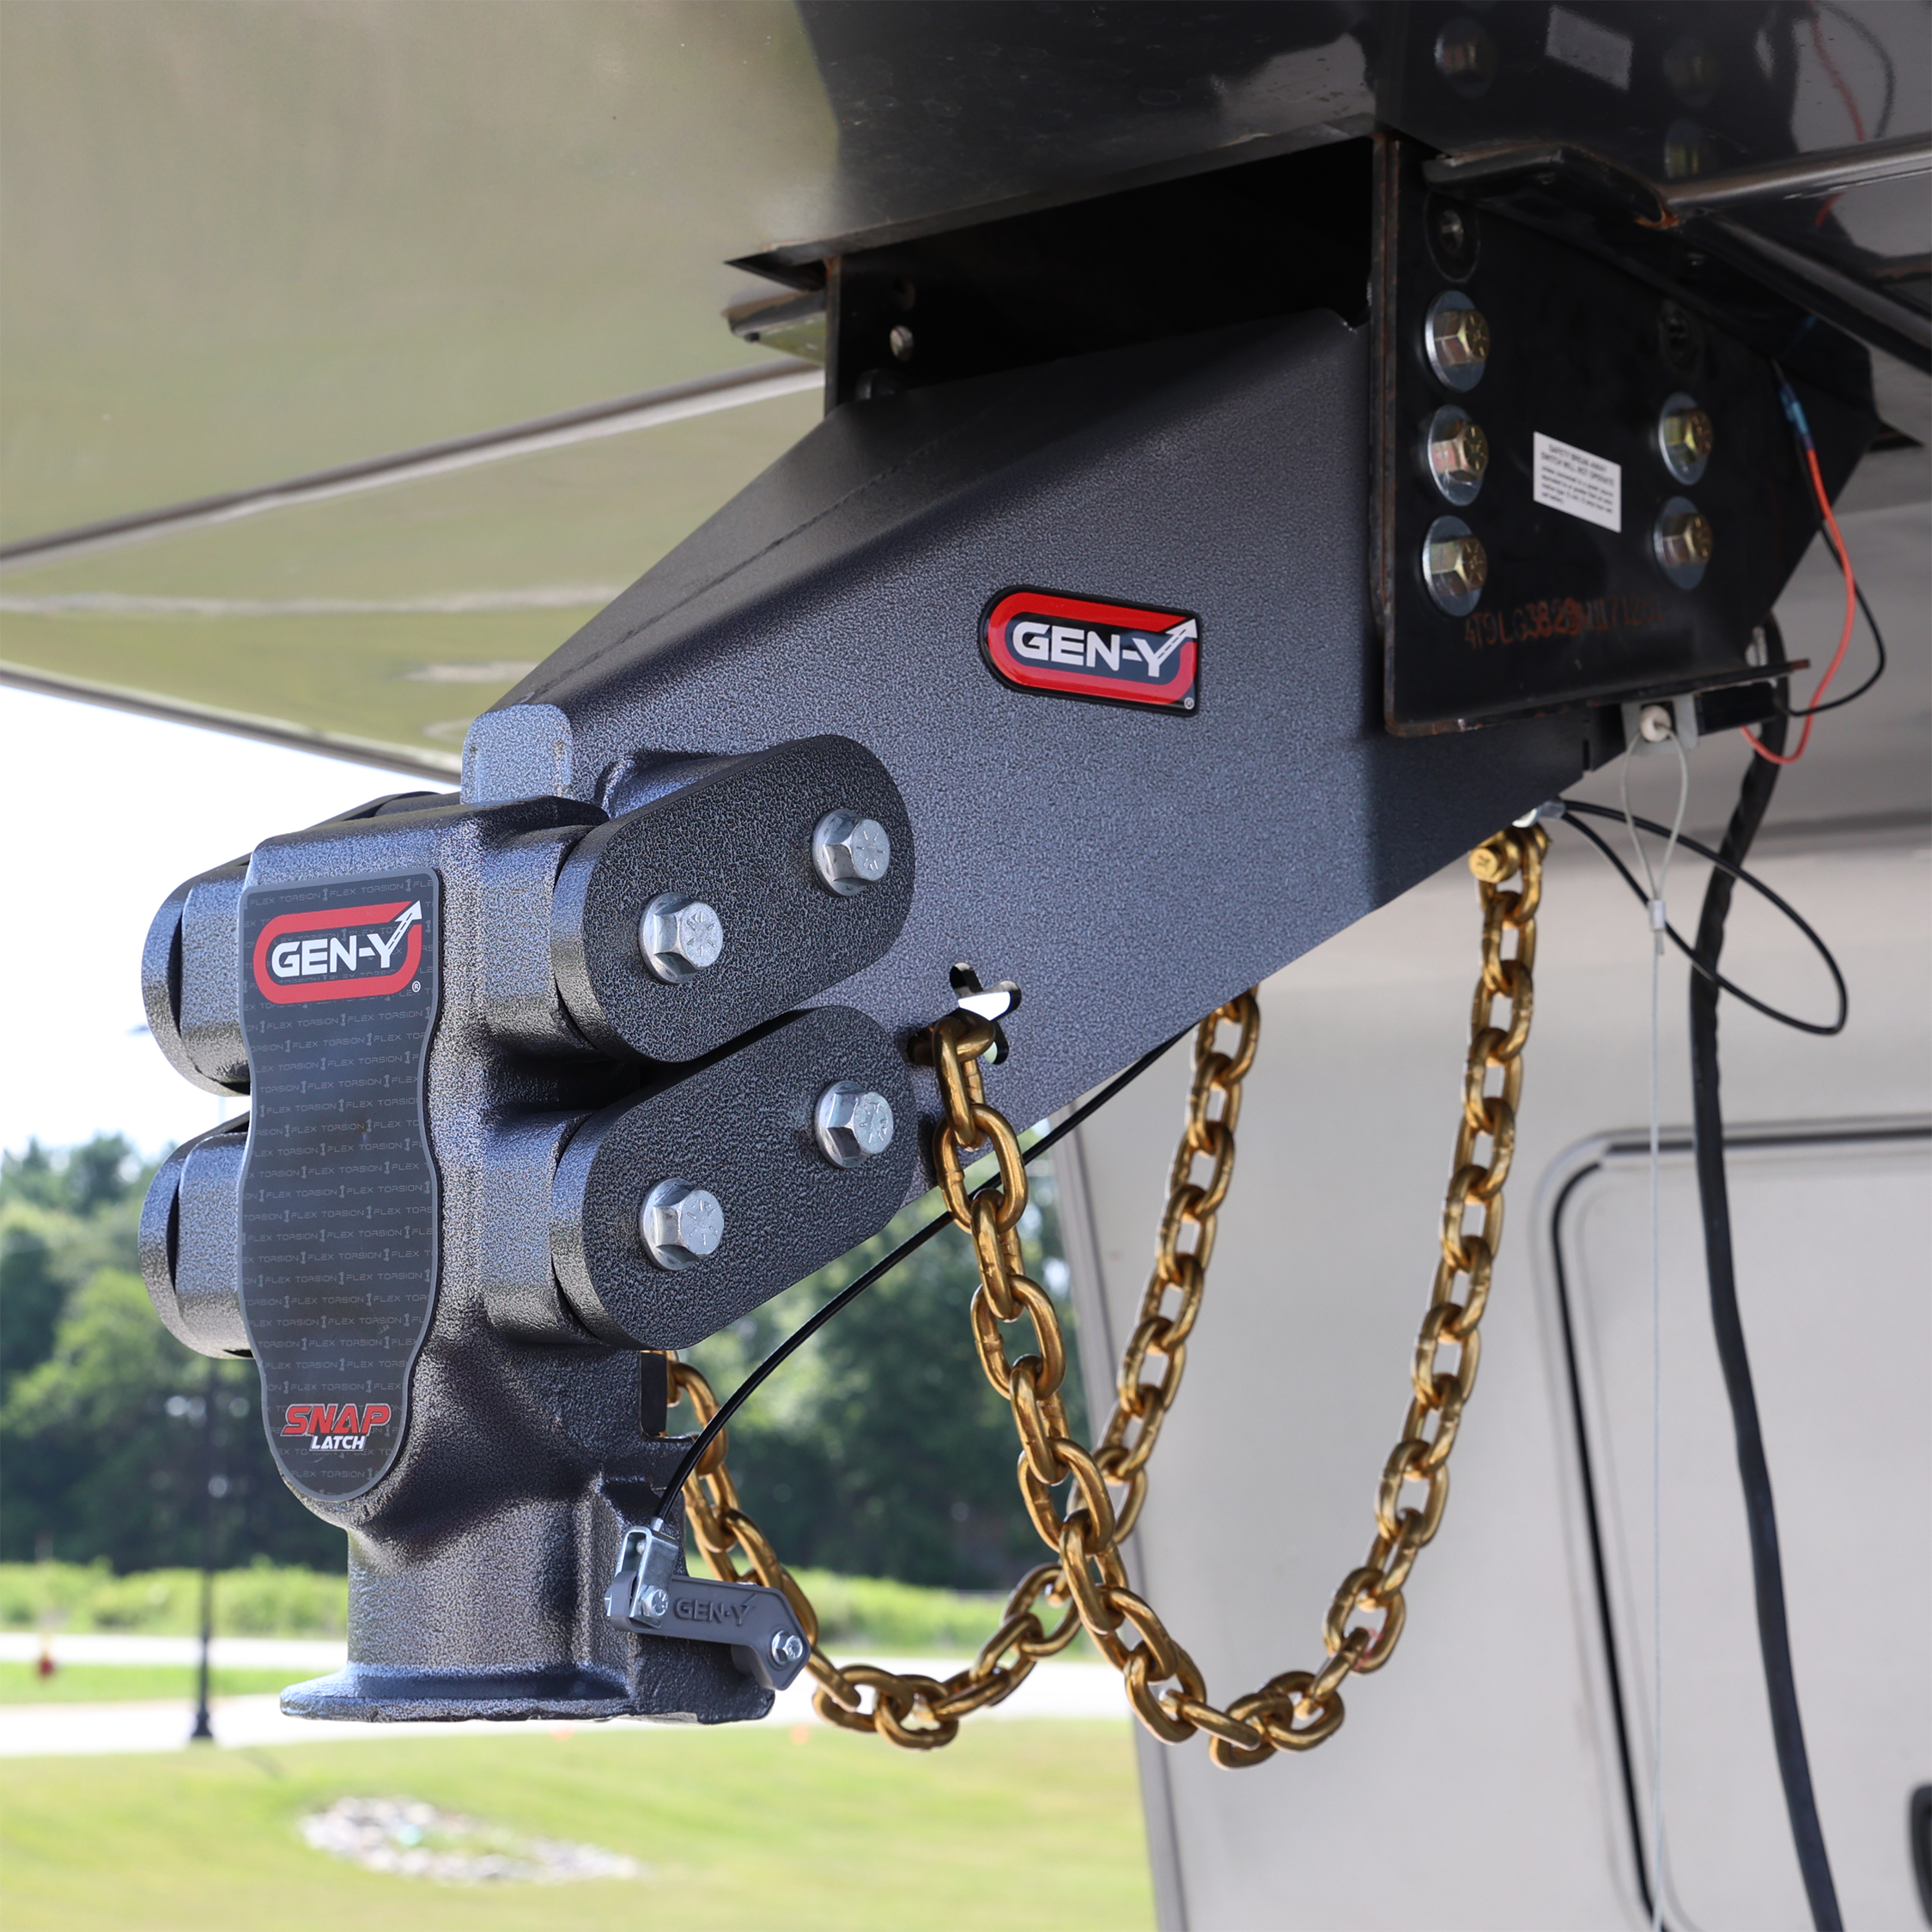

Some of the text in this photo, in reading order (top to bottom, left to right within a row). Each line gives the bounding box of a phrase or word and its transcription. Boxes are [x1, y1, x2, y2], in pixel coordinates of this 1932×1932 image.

[1013, 619, 1192, 677] GEN-Y
[279, 893, 320, 902] TORSION
[331, 888, 355, 897] FLEX
[361, 884, 404, 894] TORSION
[271, 912, 414, 978] GEN-Y
[297, 1018, 338, 1026] TORSION
[379, 1011, 422, 1020] TORSION
[323, 1037, 364, 1047] TORSION
[374, 1034, 401, 1042] FLEX
[278, 1062, 319, 1071] TORSION
[328, 1059, 354, 1067] FLEX
[358, 1055, 402, 1064] TORSION
[259, 1084, 299, 1093] TORSION
[338, 1078, 381, 1087] TORSION
[295, 1103, 336, 1112] TORSION
[346, 1100, 373, 1109] FLEX
[321, 1123, 364, 1132] TORSION
[277, 1147, 318, 1156] TORSION
[328, 1144, 354, 1152] FLEX
[359, 1141, 402, 1150] TORSION
[259, 1170, 299, 1178] TORSION
[339, 1165, 382, 1174] TORSION
[296, 1188, 337, 1197] TORSION
[378, 1184, 422, 1193] TORSION
[321, 1209, 364, 1218] TORSION
[358, 1229, 402, 1237] TORSION
[338, 1251, 381, 1260] TORSION
[392, 1249, 419, 1258] FLEX
[295, 1273, 337, 1282] TORSION
[322, 1295, 364, 1303] TORSION
[276, 1317, 319, 1326] TORSION
[359, 1315, 401, 1323] TORSION
[258, 1339, 299, 1347] TORSION
[309, 1338, 335, 1346] FLEX
[340, 1337, 382, 1346] TORSION
[295, 1360, 337, 1369] TORSION
[347, 1359, 374, 1368] FLEX
[292, 1381, 401, 1390] FLEX TORSION FLEX
[280, 1403, 392, 1437] SNAP
[310, 1436, 366, 1450] LATCH
[321, 1468, 365, 1477] TORSION
[673, 1595, 756, 1626] GEN-Y
